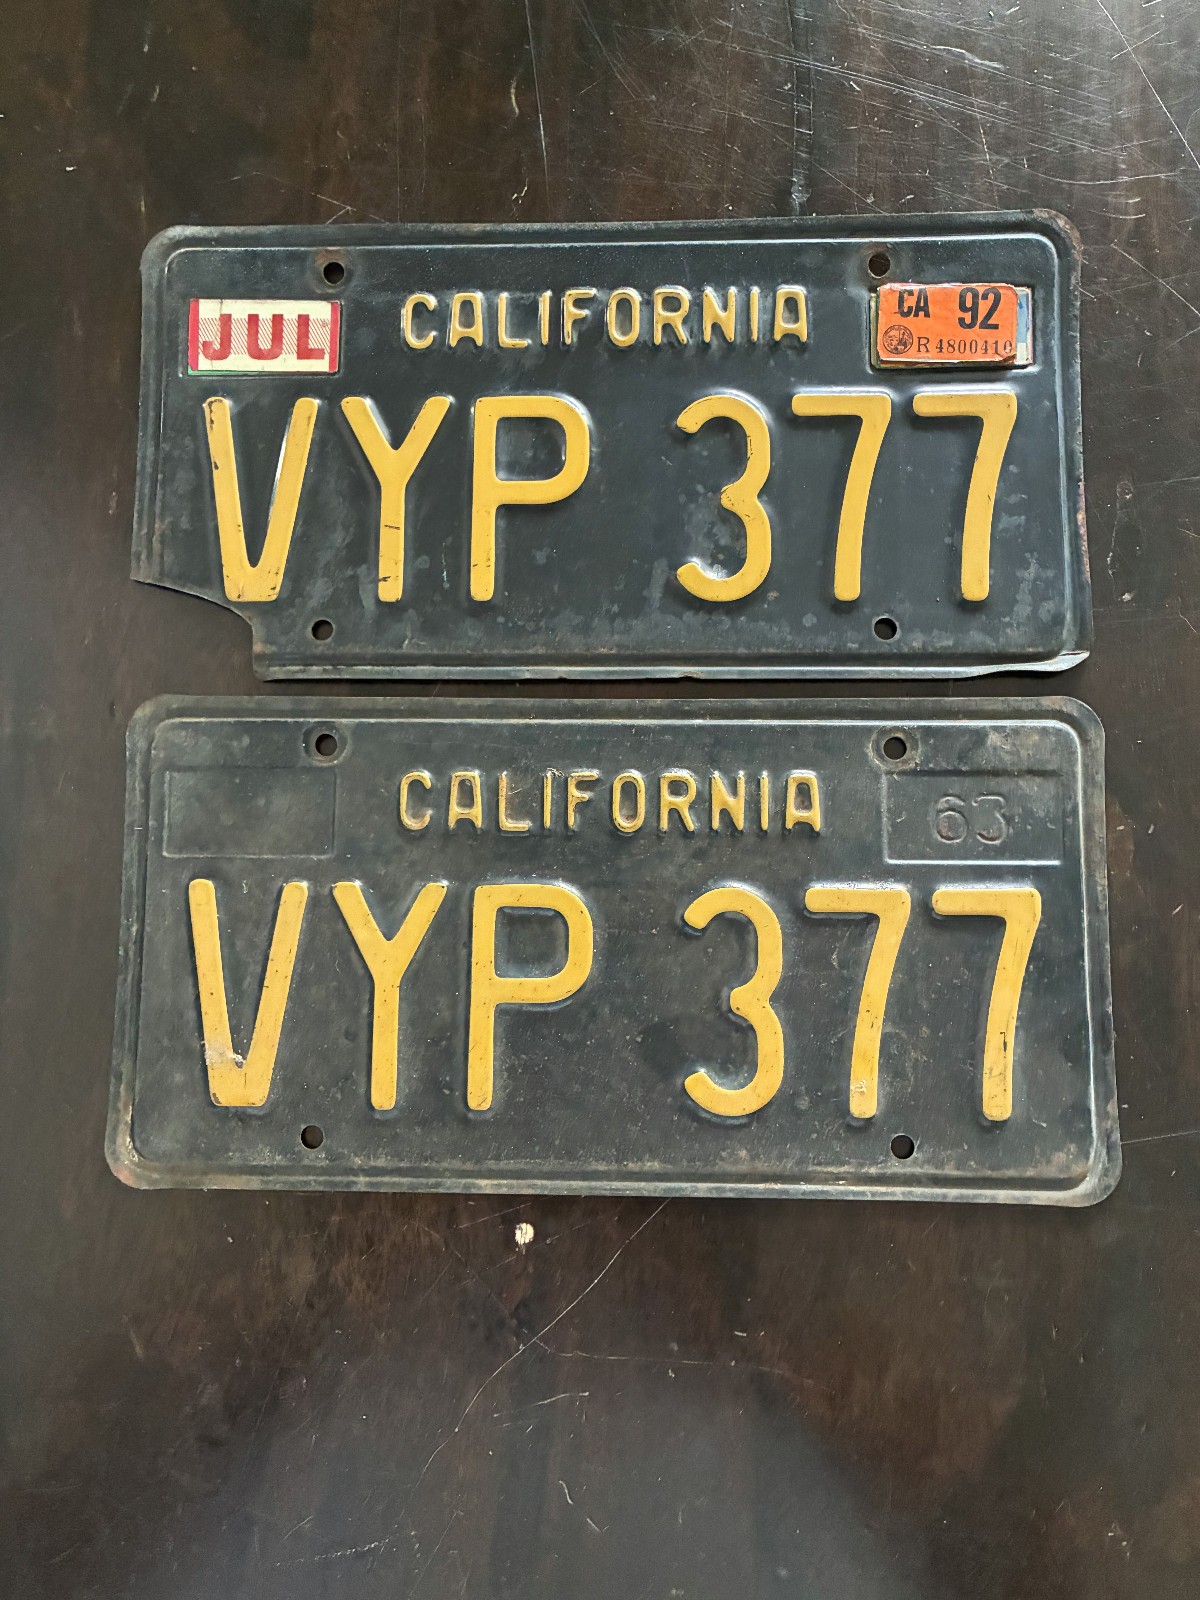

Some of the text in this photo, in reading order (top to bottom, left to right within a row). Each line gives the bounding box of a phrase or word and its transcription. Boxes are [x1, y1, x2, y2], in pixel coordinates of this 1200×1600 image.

[202, 313, 326, 361] JUL
[401, 286, 809, 351] CALIFORNIA
[897, 286, 1002, 330] CA 92
[204, 393, 1018, 602] VYP 377
[400, 770, 822, 833] CALIFORNIA
[932, 794, 1009, 844] 63
[188, 878, 1042, 1122] VYP 377
